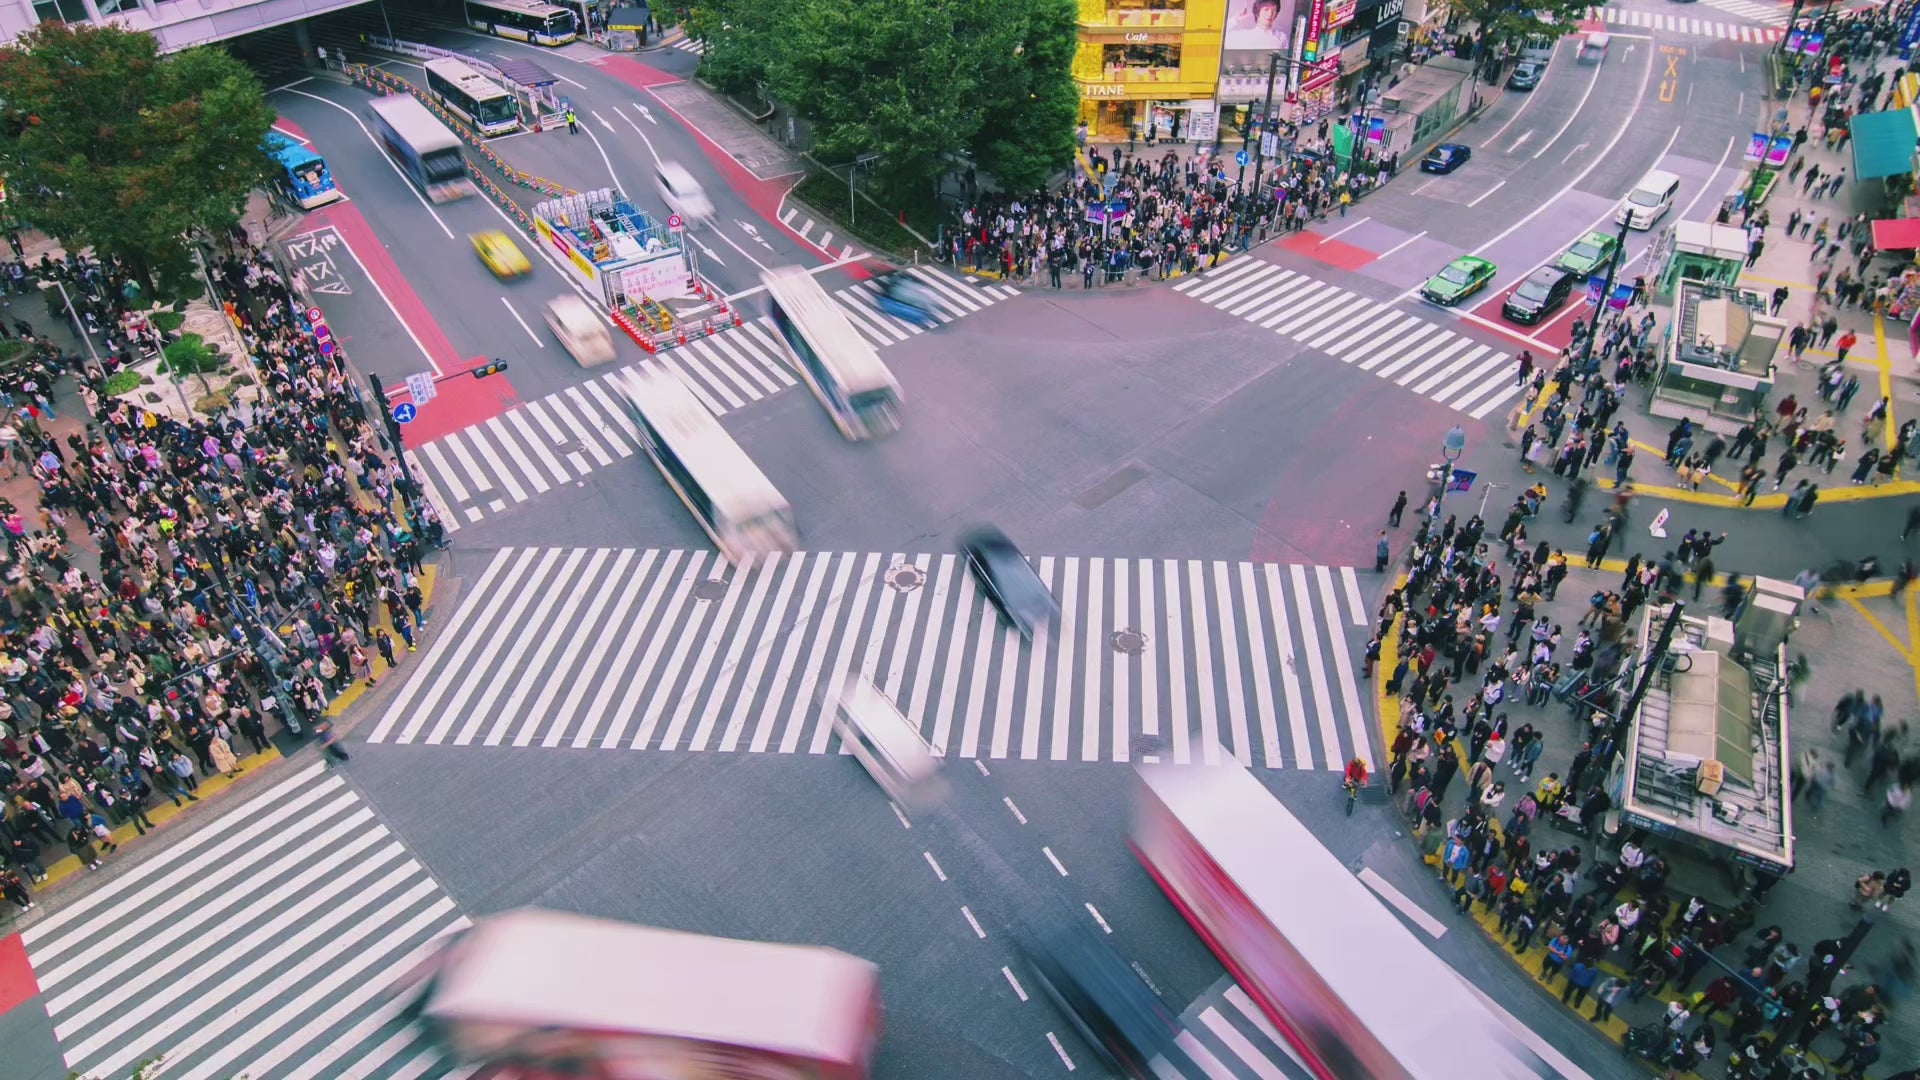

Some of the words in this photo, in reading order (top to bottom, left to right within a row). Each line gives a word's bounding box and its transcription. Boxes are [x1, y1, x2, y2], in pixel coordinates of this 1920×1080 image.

[1377, 0, 1404, 22] LUSH
[1125, 32, 1149, 42] Café
[1085, 84, 1124, 96] ITANE
